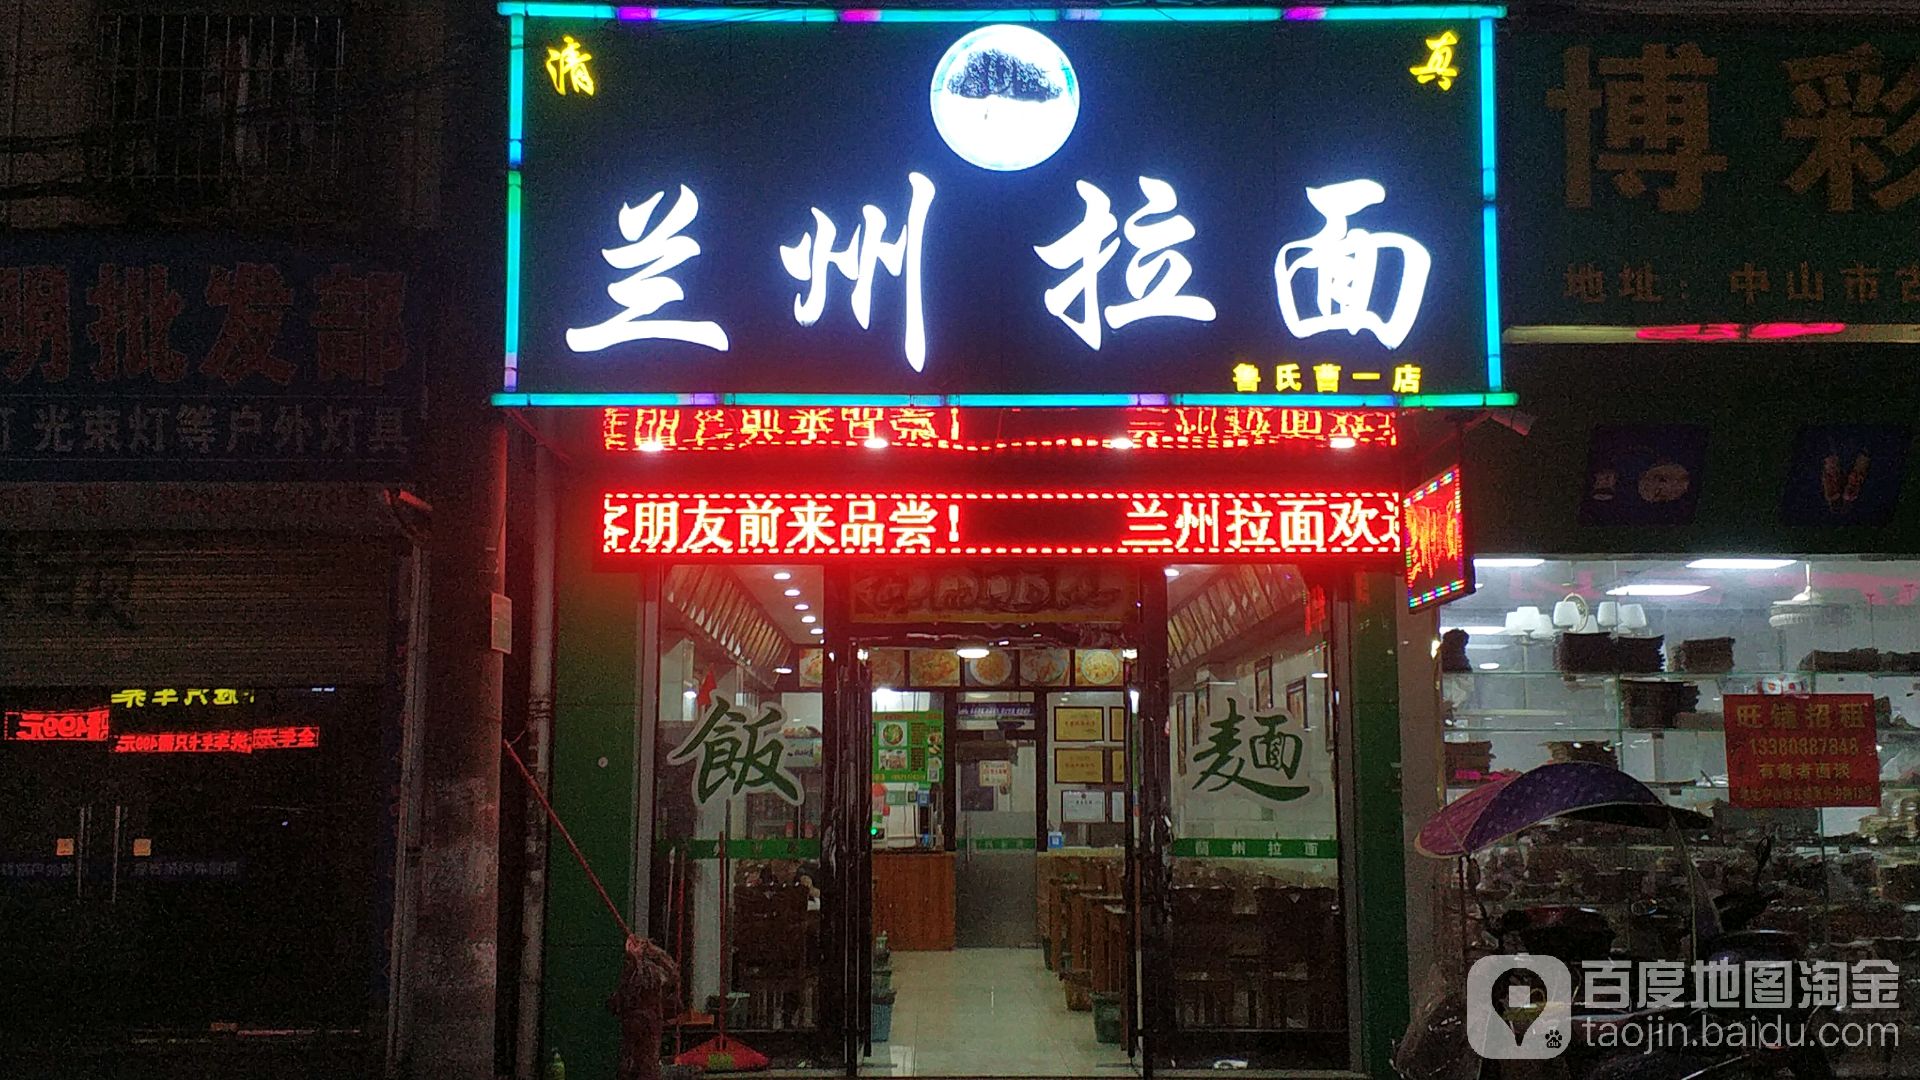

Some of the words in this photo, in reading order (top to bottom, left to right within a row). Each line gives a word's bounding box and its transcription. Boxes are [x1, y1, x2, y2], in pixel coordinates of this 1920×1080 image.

[546, 35, 595, 96] 清
[1409, 31, 1458, 91] 真
[1545, 41, 1920, 213] 博彩
[566, 172, 1430, 370] 兰州拉面
